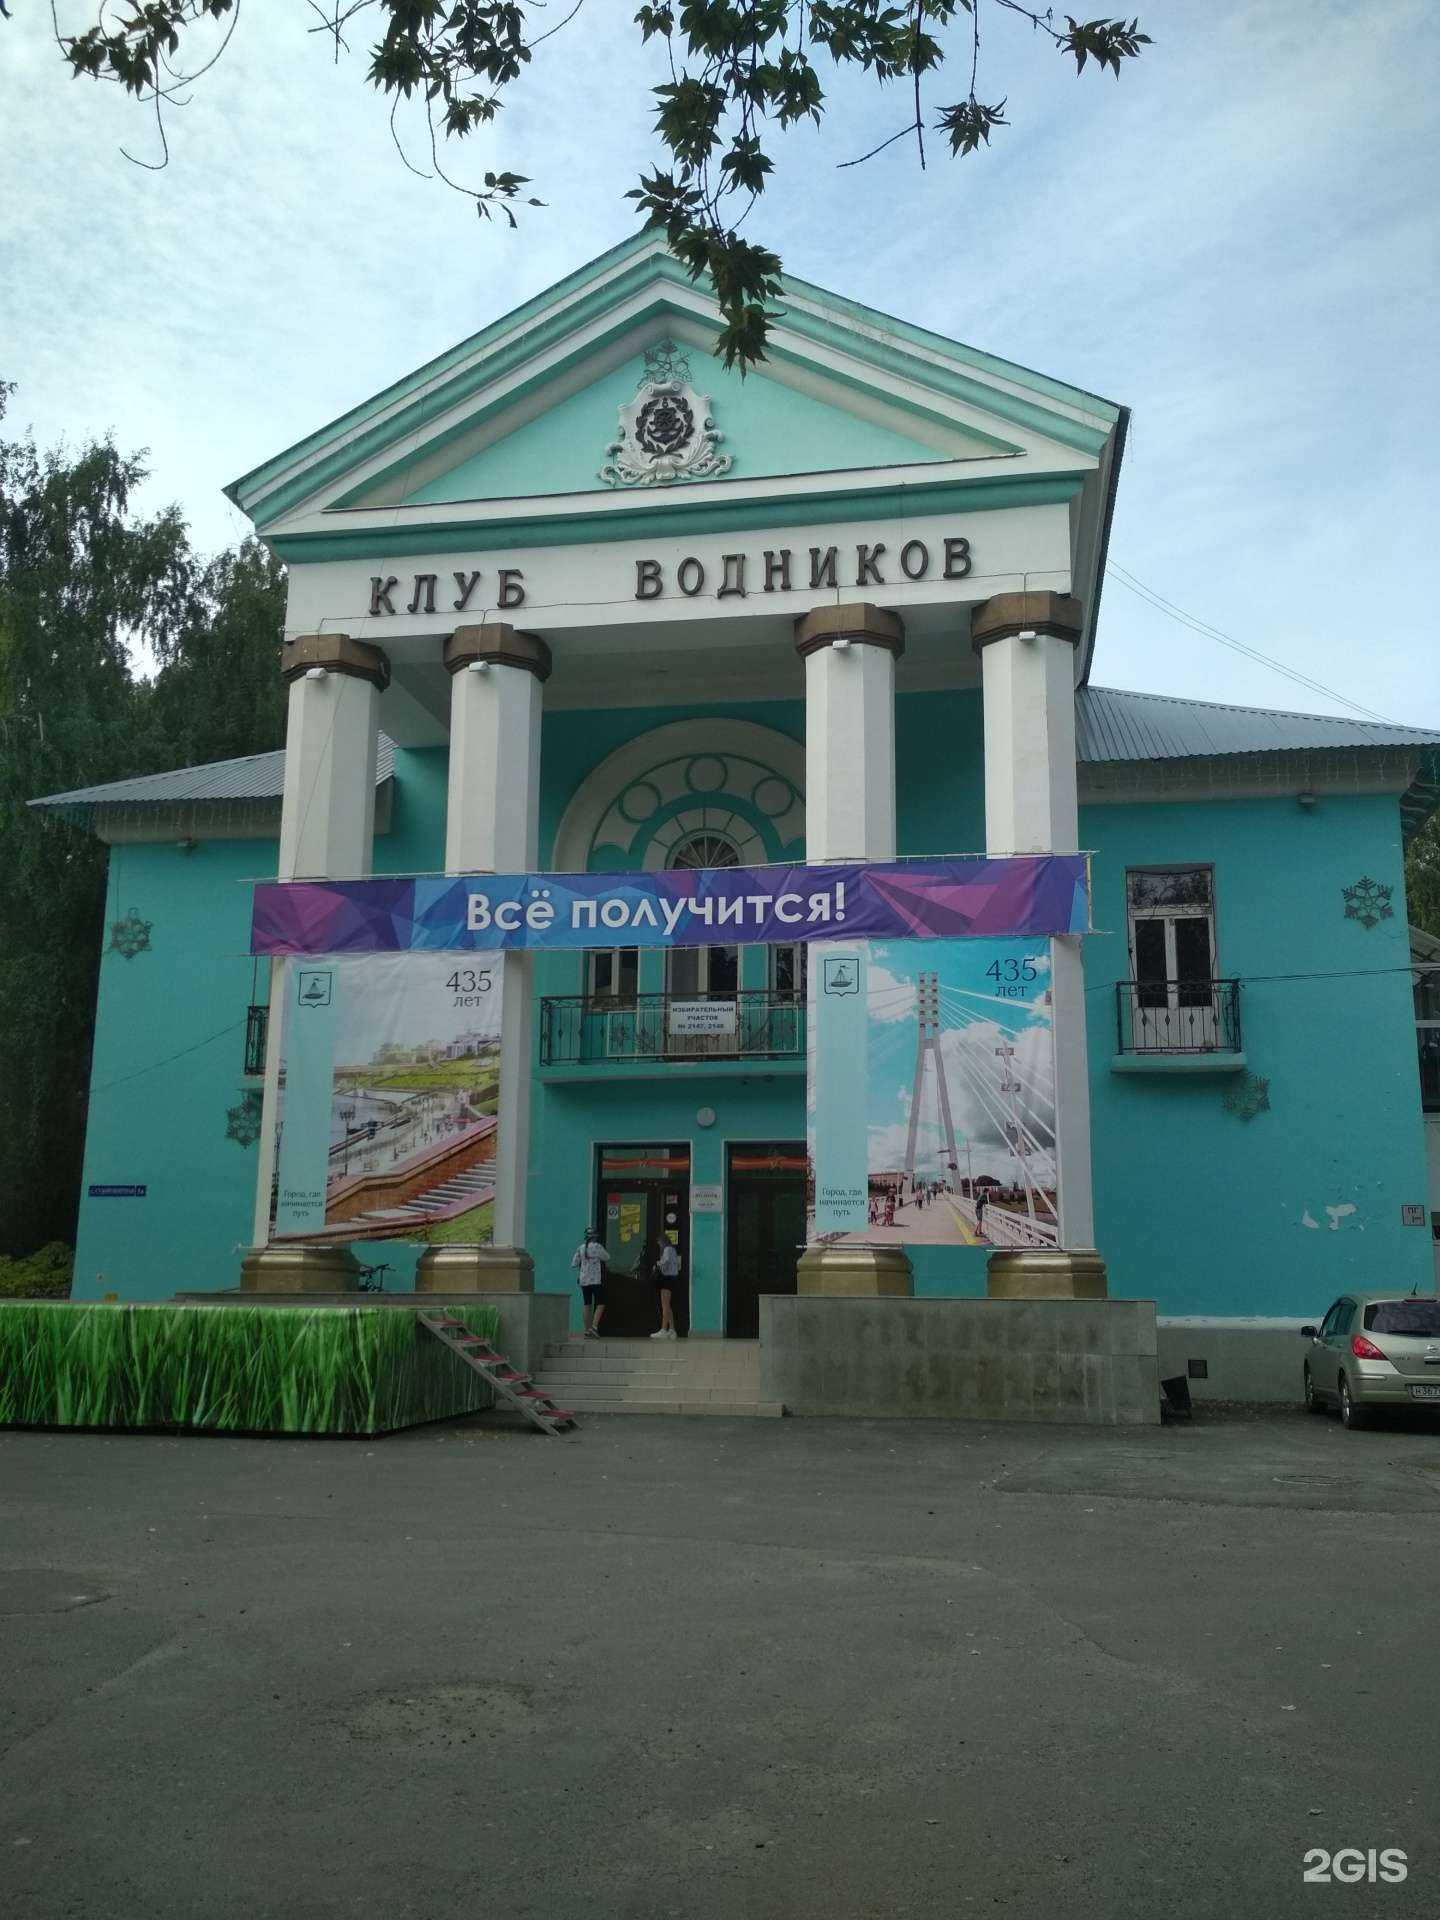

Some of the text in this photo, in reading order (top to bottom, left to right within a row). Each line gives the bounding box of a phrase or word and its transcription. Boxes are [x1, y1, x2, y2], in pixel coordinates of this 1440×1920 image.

[370, 537, 973, 615] КЛУБ ВОДНИКОВ
[466, 882, 845, 936] Всё получится!
[446, 970, 492, 993] 435
[985, 958, 1038, 982] 435
[453, 995, 483, 1008] лет
[995, 985, 1028, 997] лет
